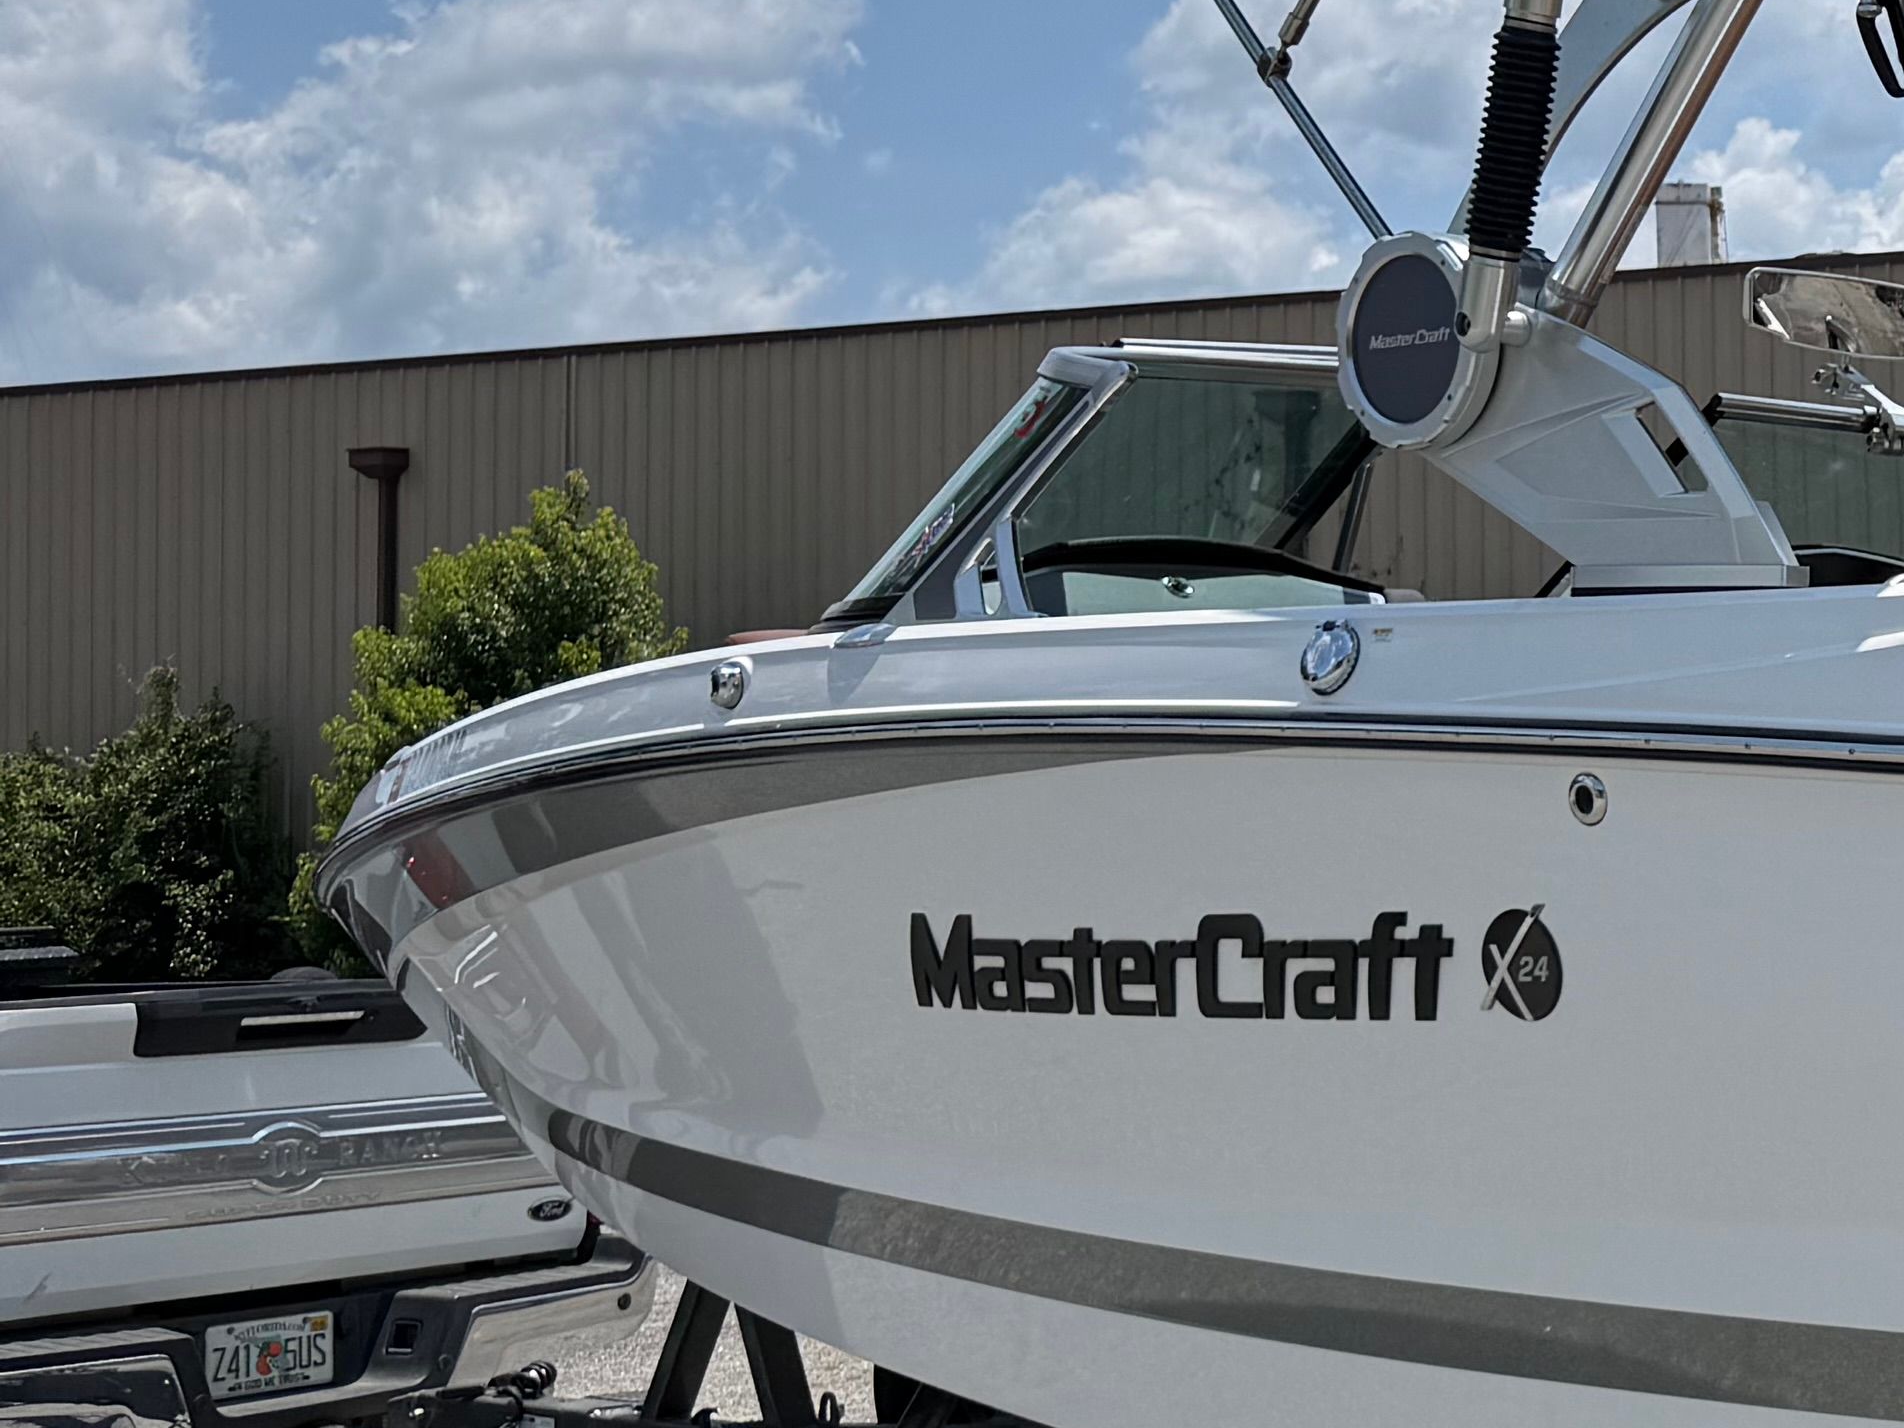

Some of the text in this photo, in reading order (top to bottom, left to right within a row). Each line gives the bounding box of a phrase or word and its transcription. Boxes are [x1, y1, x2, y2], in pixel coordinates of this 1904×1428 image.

[1368, 326, 1450, 350] MasterCraft
[910, 911, 1454, 1022] MasterCraft
[212, 1343, 251, 1383] Z41
